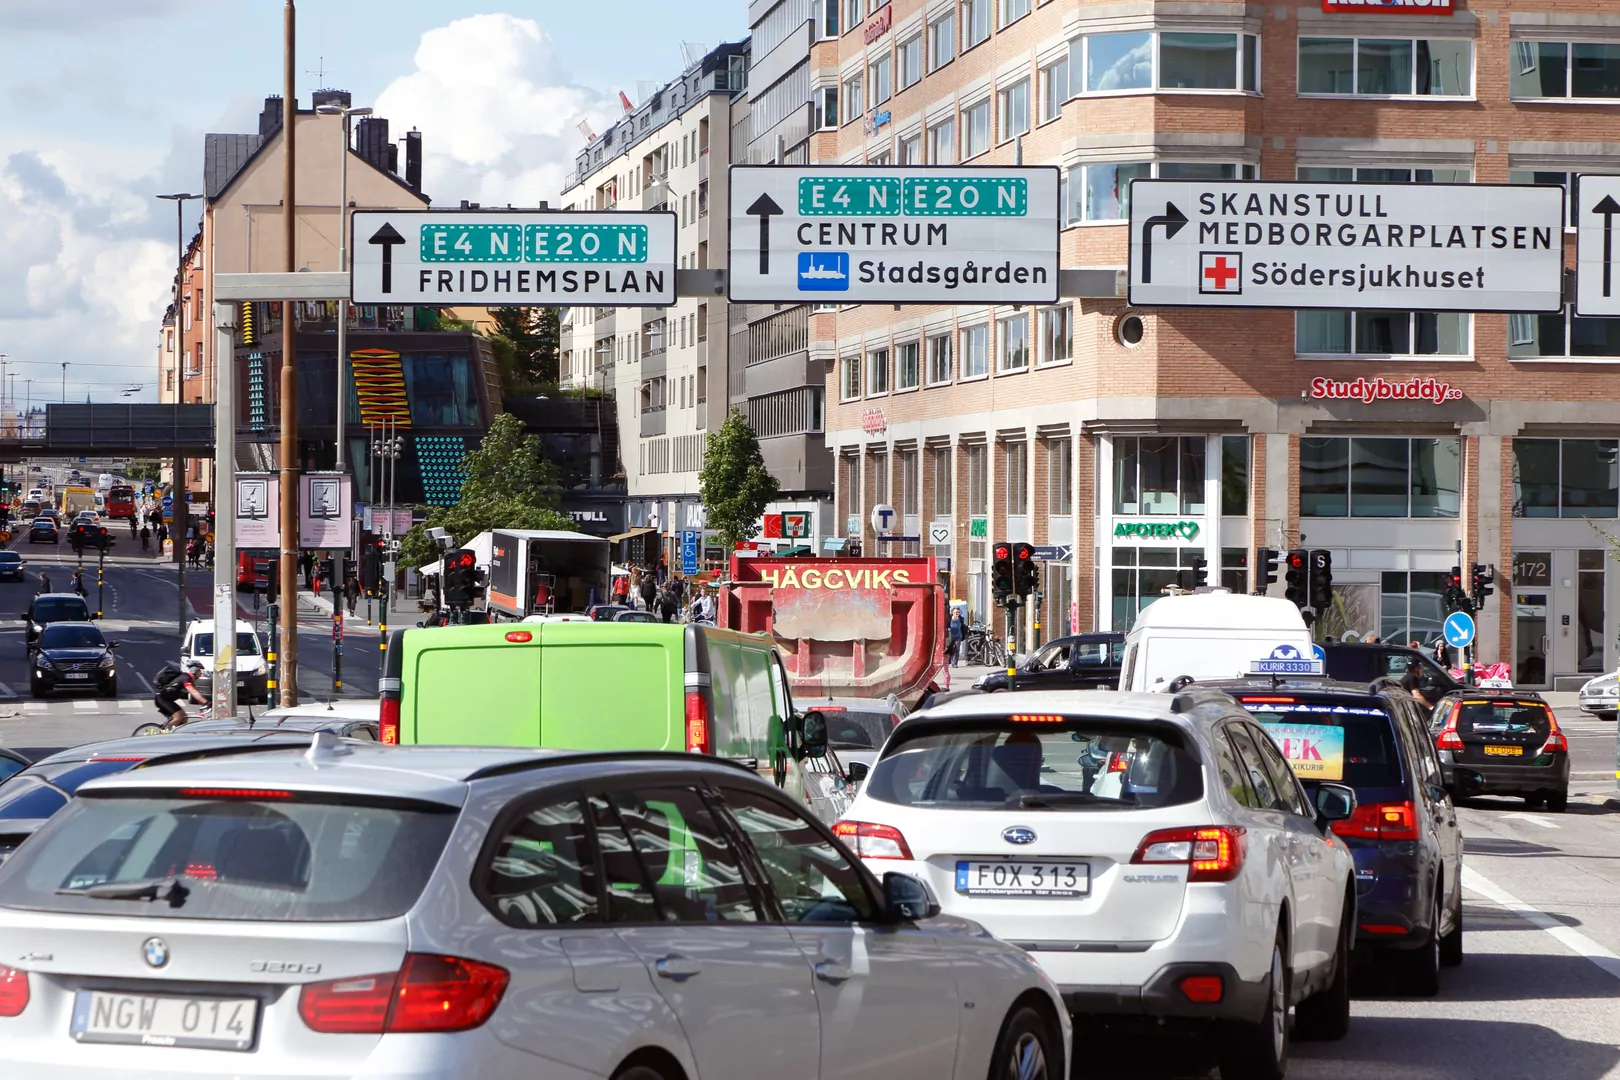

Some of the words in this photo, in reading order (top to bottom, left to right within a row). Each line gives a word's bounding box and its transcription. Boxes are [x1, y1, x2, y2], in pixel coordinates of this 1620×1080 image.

[812, 185, 851, 208] E4
[869, 185, 887, 208] N
[914, 185, 979, 208] E20
[997, 185, 1016, 209] N
[1199, 192, 1388, 218] SKANSTULL
[433, 232, 472, 255] E4
[490, 232, 509, 255] N
[535, 232, 600, 255] E20
[618, 232, 637, 255] N
[797, 222, 947, 246] CENTRUM
[1199, 222, 1551, 250] MEDBORGARPLATSEN
[419, 269, 664, 293] FRIDHEMSPLAN
[858, 260, 1047, 289] Stadsgården
[1251, 262, 1485, 292] Södersjukhuset
[1312, 377, 1462, 404] Studybuddy.se
[788, 516, 803, 537] 7
[879, 510, 893, 528] T
[1114, 522, 1177, 537] APOTEK
[685, 531, 694, 543] P
[1317, 555, 1326, 568] S
[1519, 562, 1546, 577] 172
[1260, 662, 1285, 671] KURIR
[1285, 663, 1310, 671] 3330
[1279, 738, 1323, 761] EK
[977, 864, 1023, 887] FOX
[1031, 866, 1077, 888] 313
[250, 960, 322, 974] 320d
[92, 995, 159, 1031] NGW
[181, 1000, 244, 1036] 014
